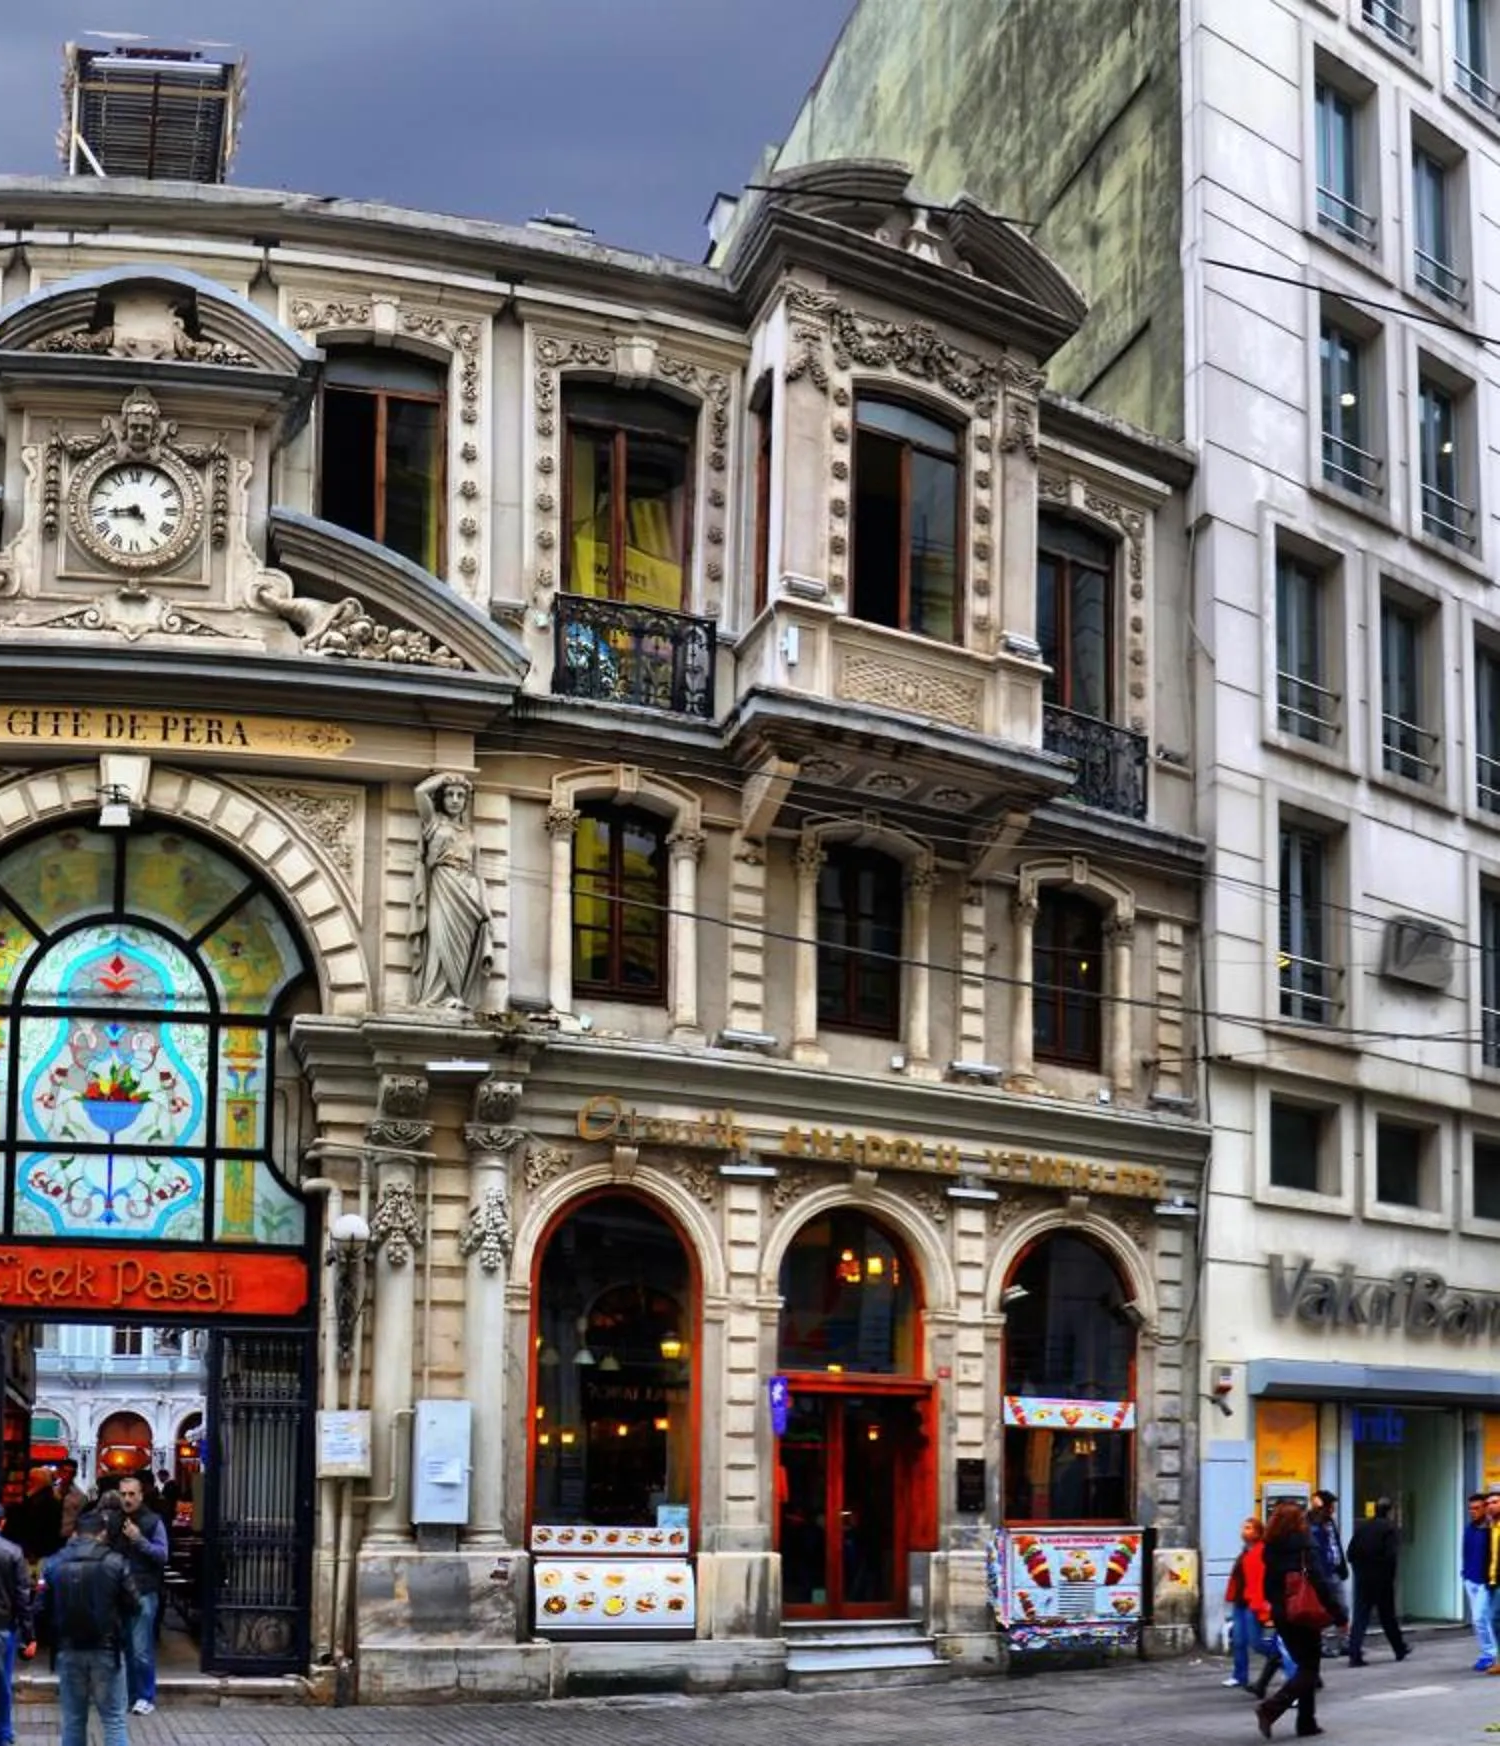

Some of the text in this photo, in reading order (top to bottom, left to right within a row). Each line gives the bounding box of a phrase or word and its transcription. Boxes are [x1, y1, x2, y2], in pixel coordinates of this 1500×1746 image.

[105, 712, 147, 741] DE
[781, 1126, 960, 1173] ANADOLU
[110, 1259, 235, 1312] Pasajı
